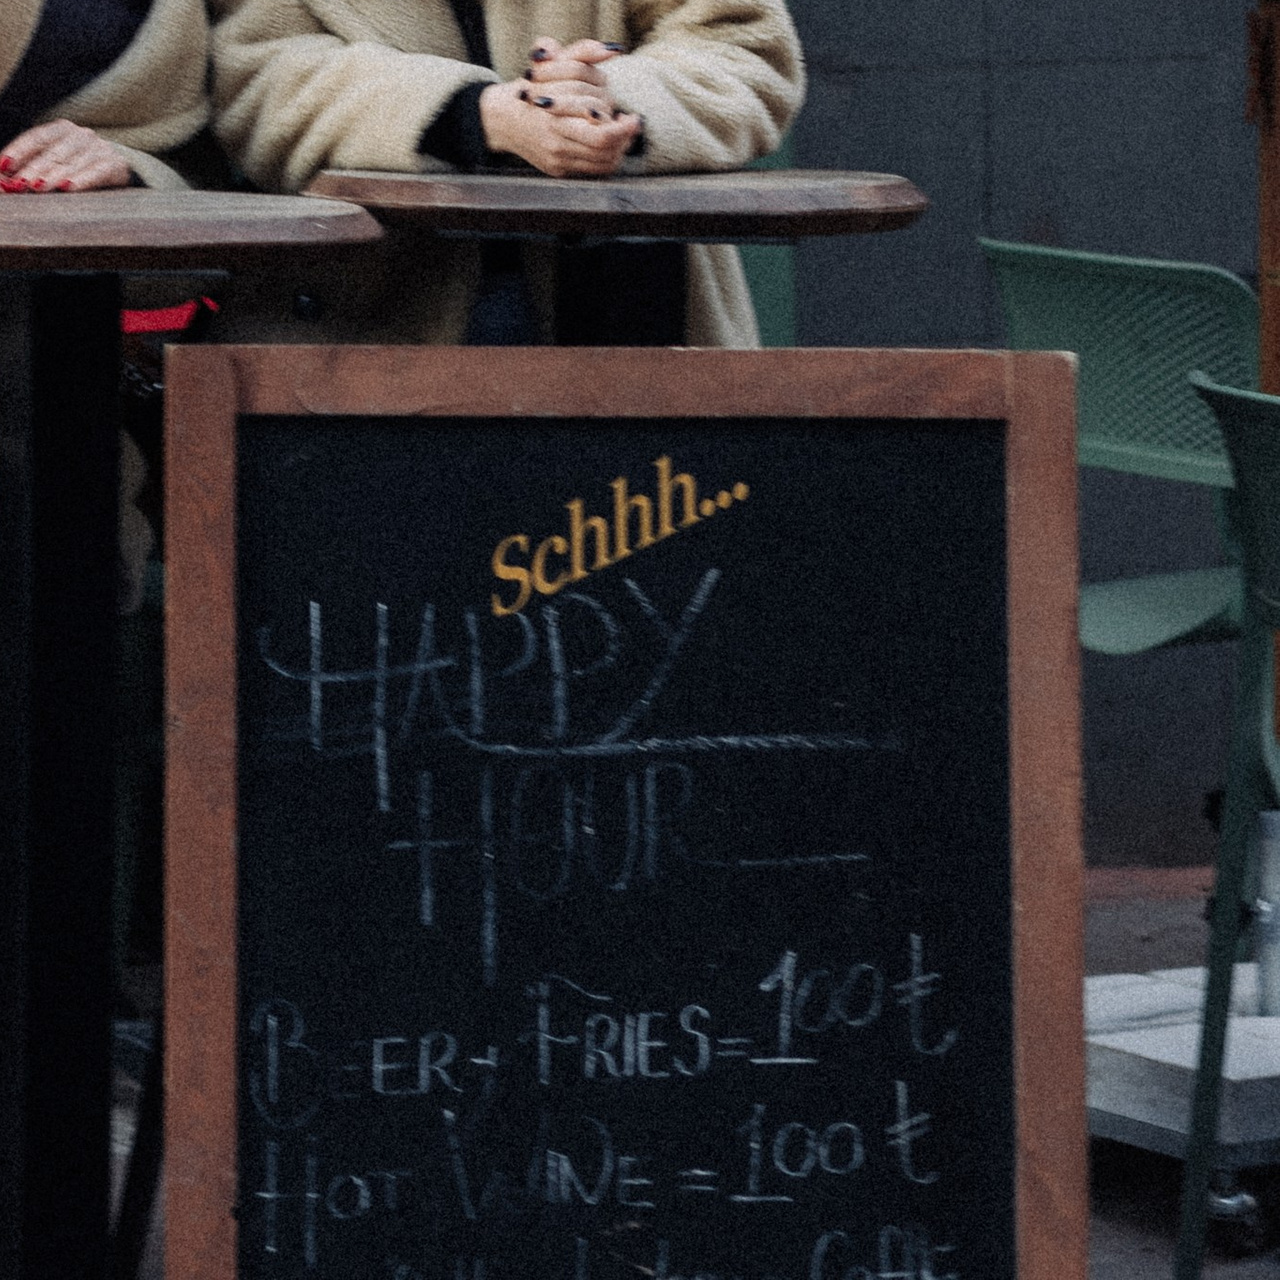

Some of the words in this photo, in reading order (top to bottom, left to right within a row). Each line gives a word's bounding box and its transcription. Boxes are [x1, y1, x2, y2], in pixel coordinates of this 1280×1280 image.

[491, 454, 751, 618] Schhh...
[258, 568, 720, 812] HAPPY
[386, 760, 702, 986] HOUR
